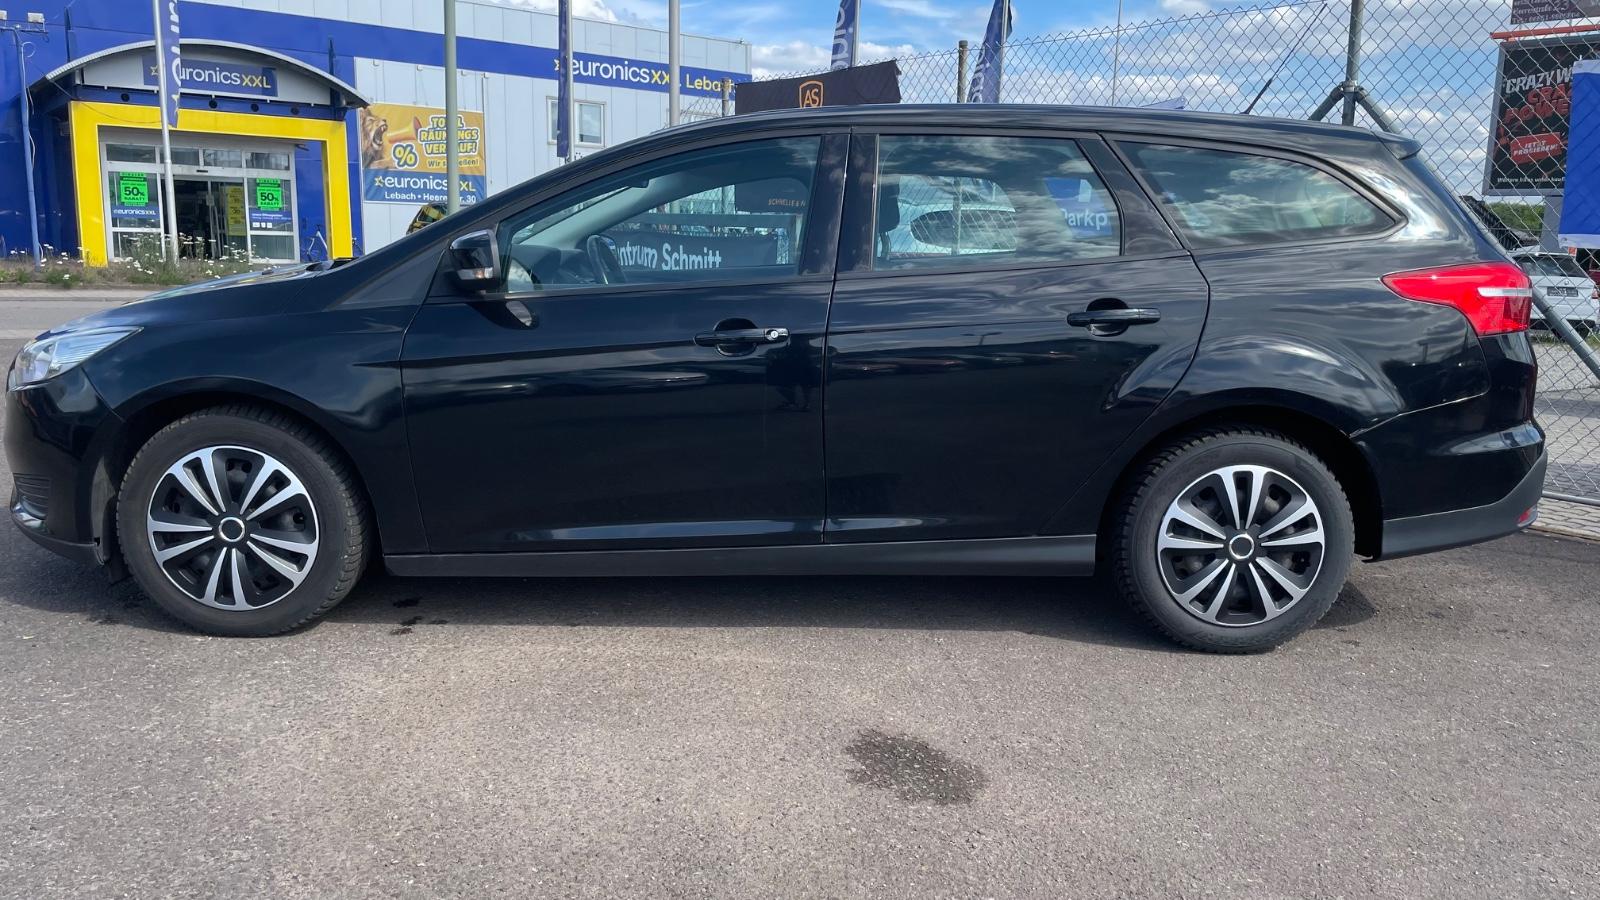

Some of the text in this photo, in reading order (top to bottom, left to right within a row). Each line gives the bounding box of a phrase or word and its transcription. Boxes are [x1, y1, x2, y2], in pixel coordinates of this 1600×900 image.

[572, 59, 736, 95] euronicsXX Lebah
[1505, 71, 1555, 94] CRAZY
[803, 88, 819, 108] AS
[1527, 83, 1572, 104] CRA
[1504, 98, 1569, 123] POWE
[431, 116, 464, 128] TOL
[421, 128, 478, 141] RÄUNGS
[426, 142, 476, 154] VERUF!
[428, 159, 441, 168] Wir
[124, 186, 145, 197] 50%
[260, 191, 279, 202] 50%
[385, 191, 416, 200] Lebach
[466, 194, 476, 203] 30
[617, 241, 722, 271] ntrum Schmitt
